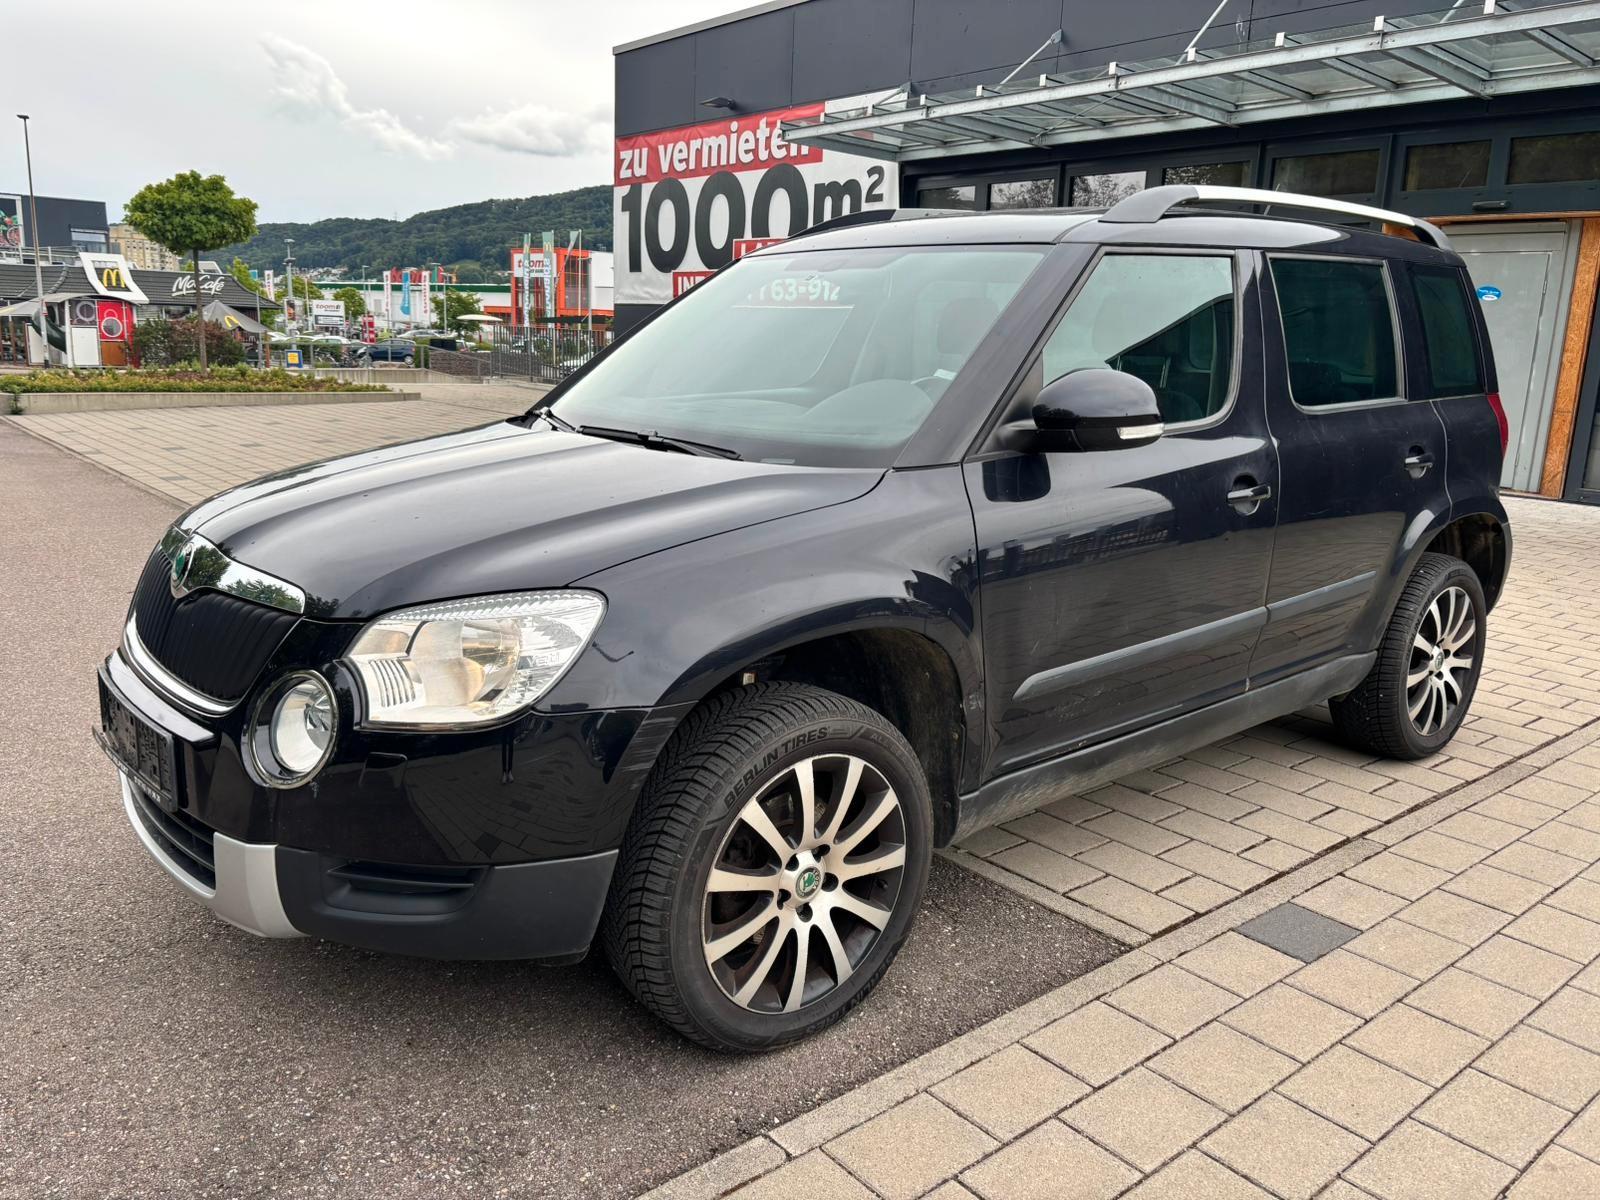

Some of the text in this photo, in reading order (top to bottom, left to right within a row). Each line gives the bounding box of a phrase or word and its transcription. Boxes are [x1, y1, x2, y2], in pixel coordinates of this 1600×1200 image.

[620, 147, 649, 179] zu
[723, 726, 828, 809] BERLIN TIRES
